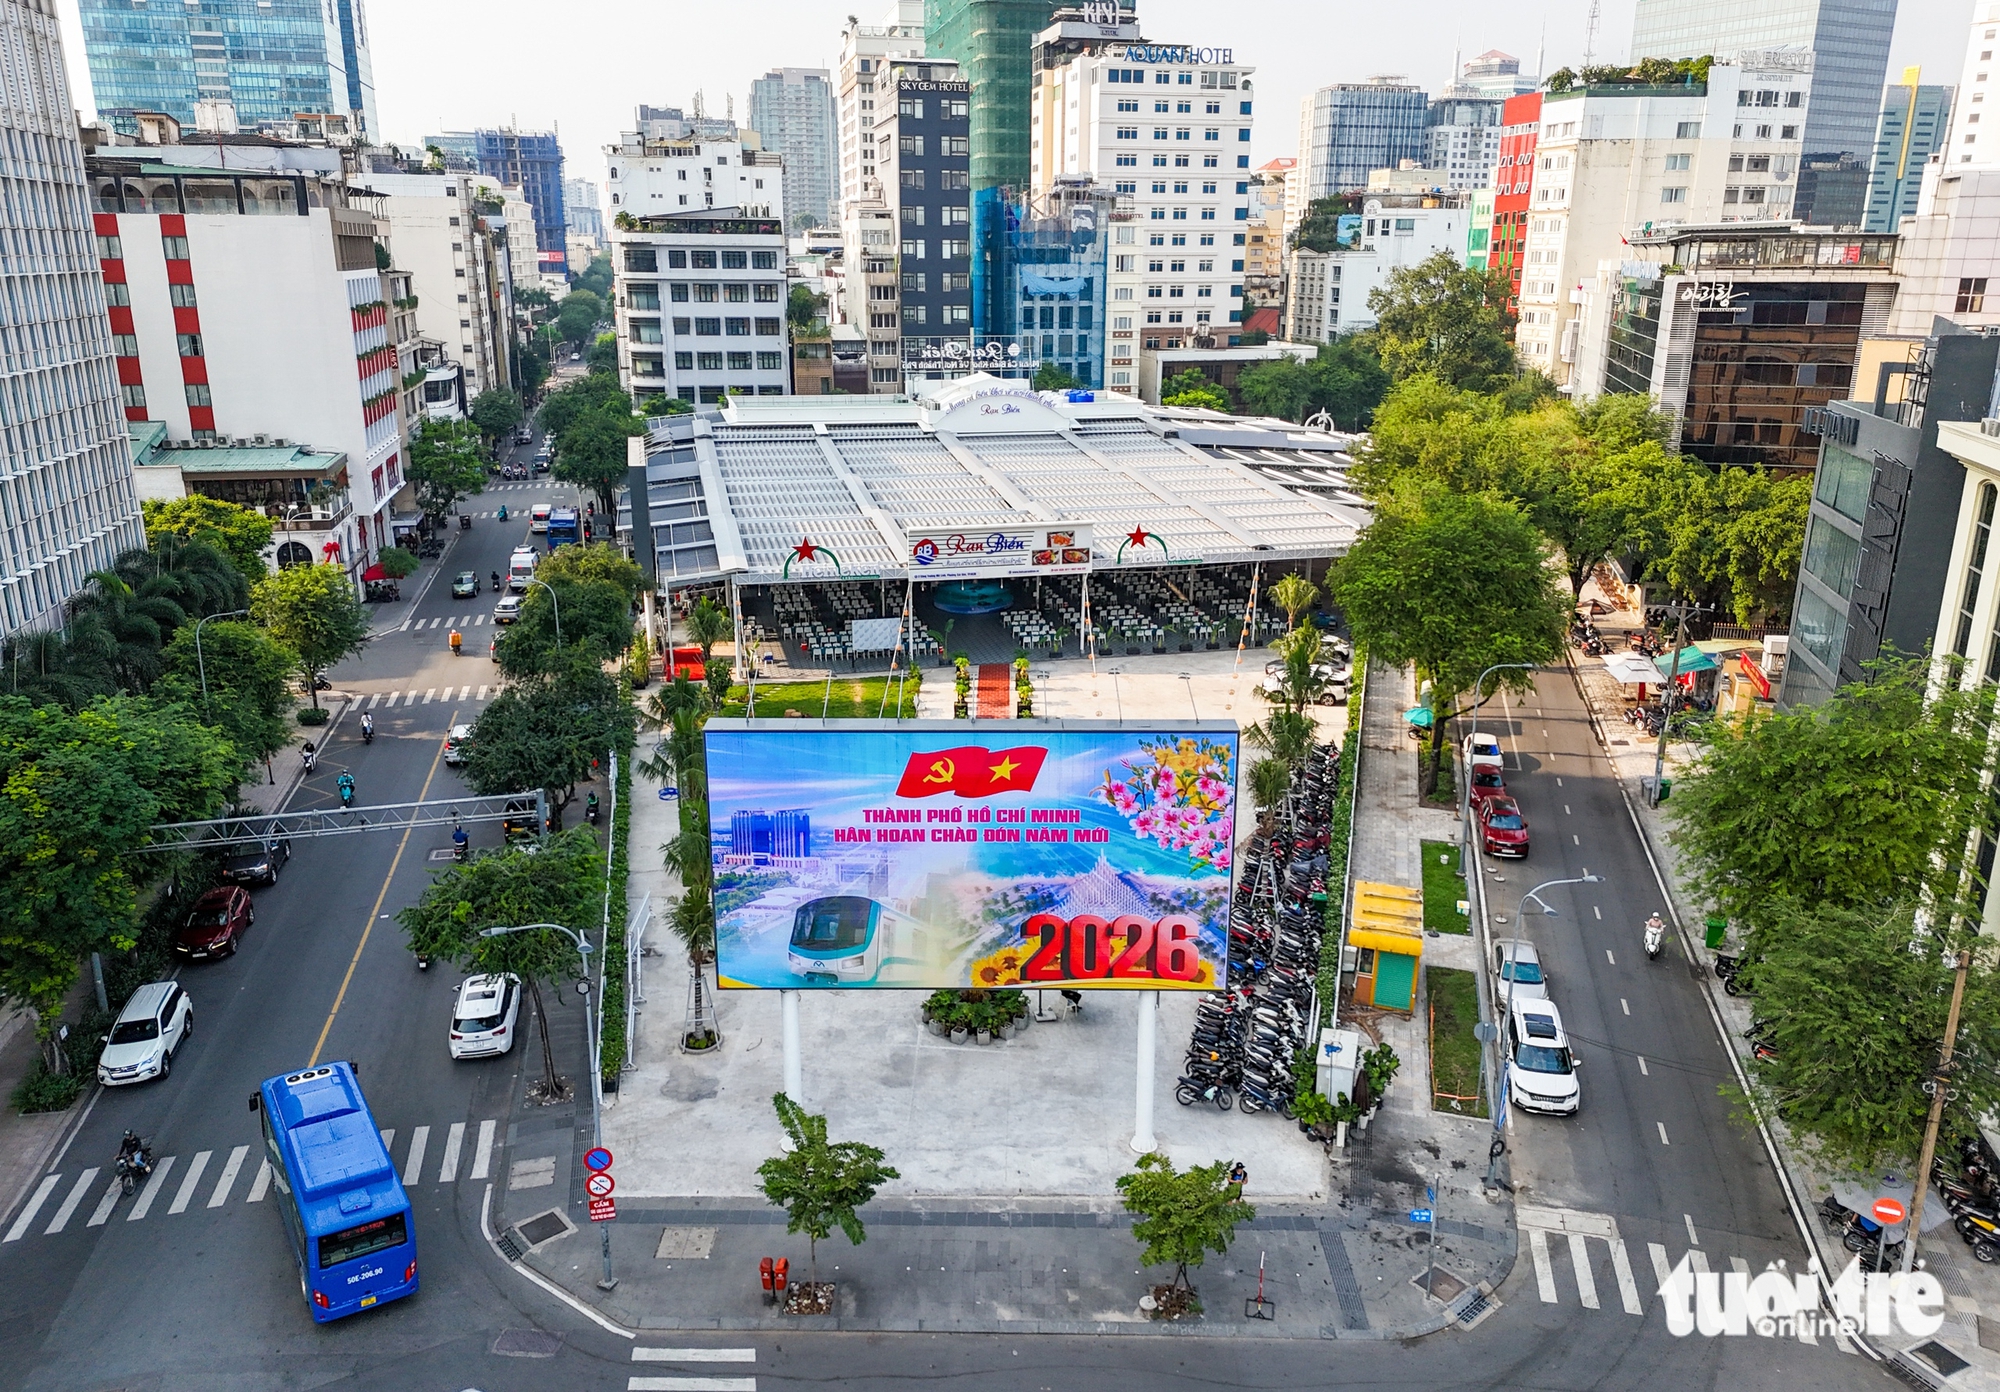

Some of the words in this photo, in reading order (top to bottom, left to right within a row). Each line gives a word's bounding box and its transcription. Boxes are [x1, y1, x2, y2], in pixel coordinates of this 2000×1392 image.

[1190, 47, 1235, 65] HOTEL
[939, 82, 968, 92] HOTEL
[917, 544, 933, 556] RB
[946, 534, 984, 557] Rạn
[986, 532, 1025, 554] Biển
[800, 563, 880, 578] Heineken
[863, 807, 922, 823] THÀNH
[927, 805, 963, 823] PHỐ
[967, 805, 991, 823] HỒ
[996, 807, 1026, 823] CHÍ
[1031, 809, 1081, 823] MINH
[834, 827, 872, 843] HÂN
[877, 828, 926, 843] HOAN
[931, 827, 978, 843] CHÀO
[983, 827, 1021, 843] ĐÓN
[1026, 827, 1069, 843] NĂM
[1074, 827, 1110, 843] MỚI
[1020, 913, 1199, 981] 2026
